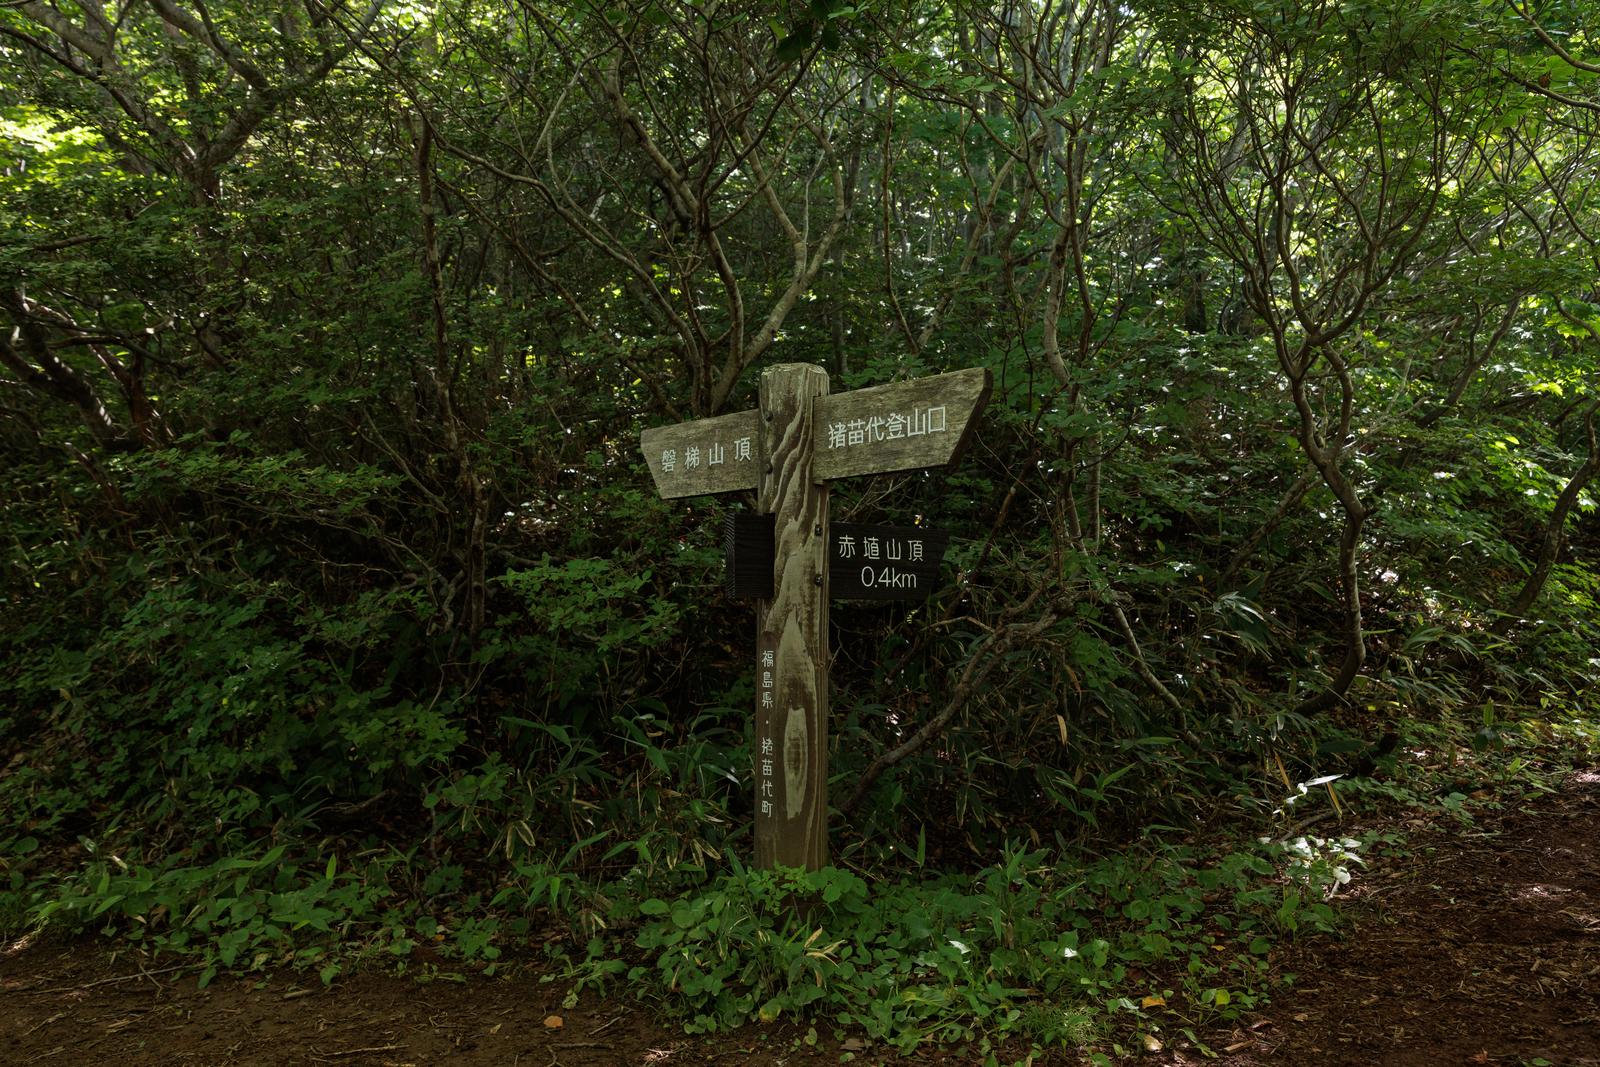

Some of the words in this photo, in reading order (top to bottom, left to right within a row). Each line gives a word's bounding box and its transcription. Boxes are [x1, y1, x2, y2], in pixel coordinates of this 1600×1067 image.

[828, 406, 946, 449] 猪苗代登山口
[661, 436, 752, 473] 磐梯山頂
[838, 535, 924, 562] 赤埴山頂
[861, 566, 917, 588] 0.4km
